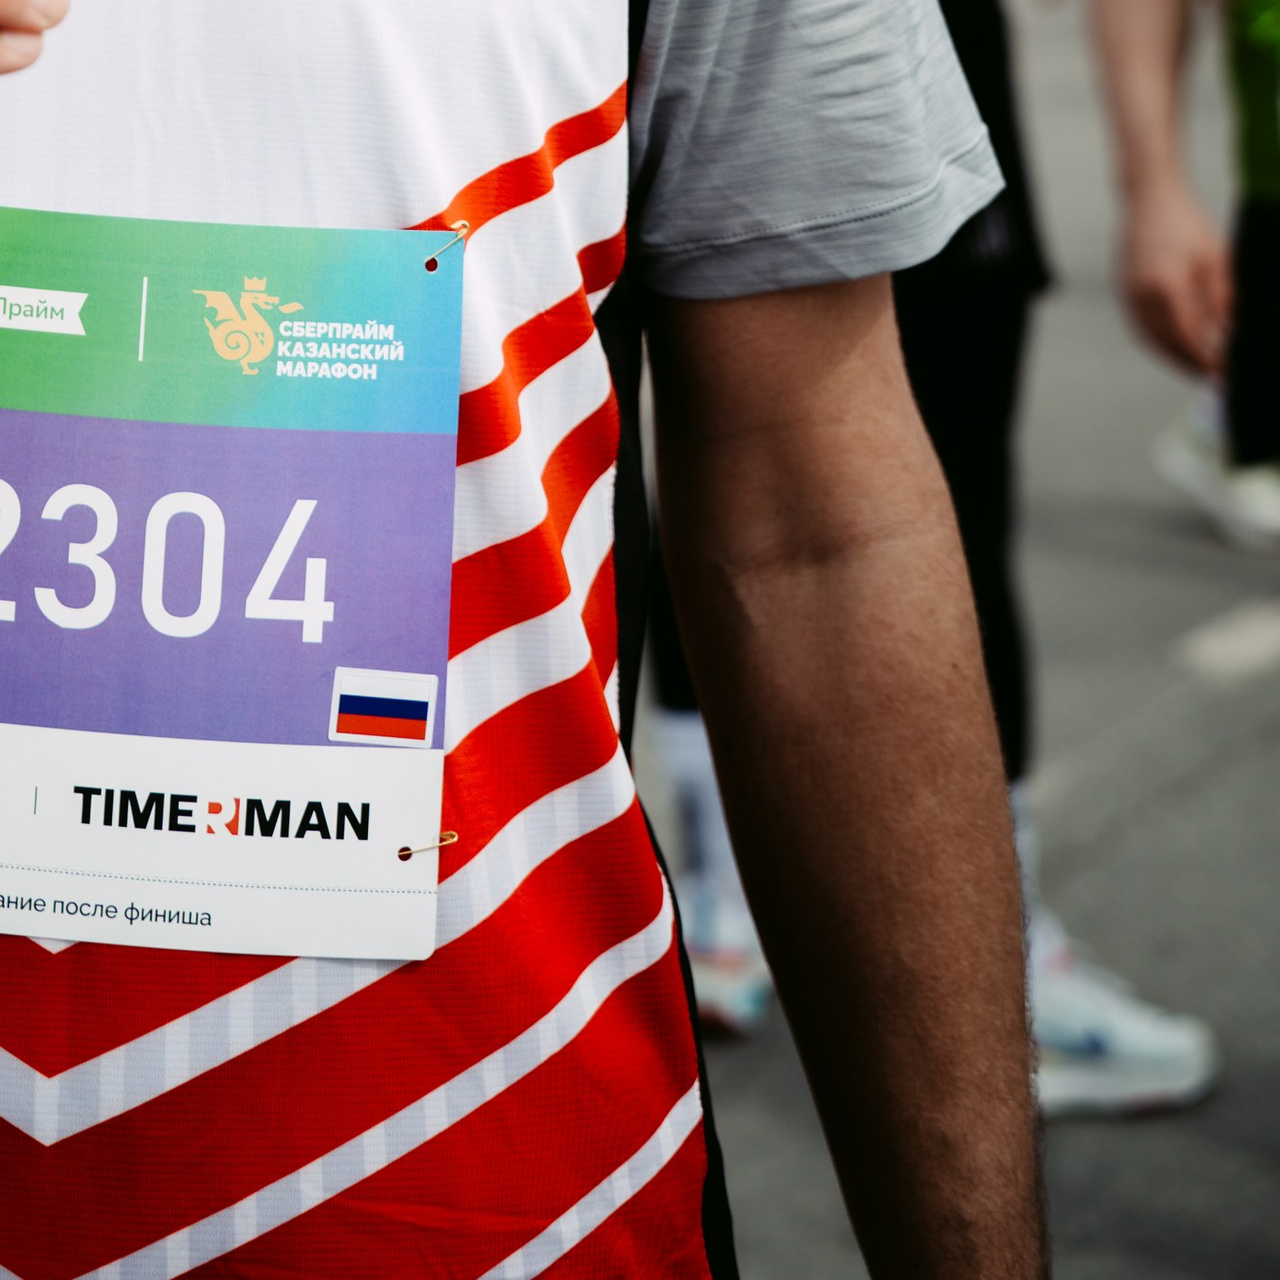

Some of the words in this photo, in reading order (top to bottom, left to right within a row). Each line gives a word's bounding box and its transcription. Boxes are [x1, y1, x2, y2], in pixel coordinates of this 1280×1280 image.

[279, 320, 394, 340] СБЕРПРАЙМ
[277, 340, 404, 361] КАЗАНСКИЙ
[276, 360, 377, 380] МАРАФОН
[73, 785, 371, 841] TIMERMAN
[52, 899, 118, 920] после
[123, 902, 213, 927] финиша
